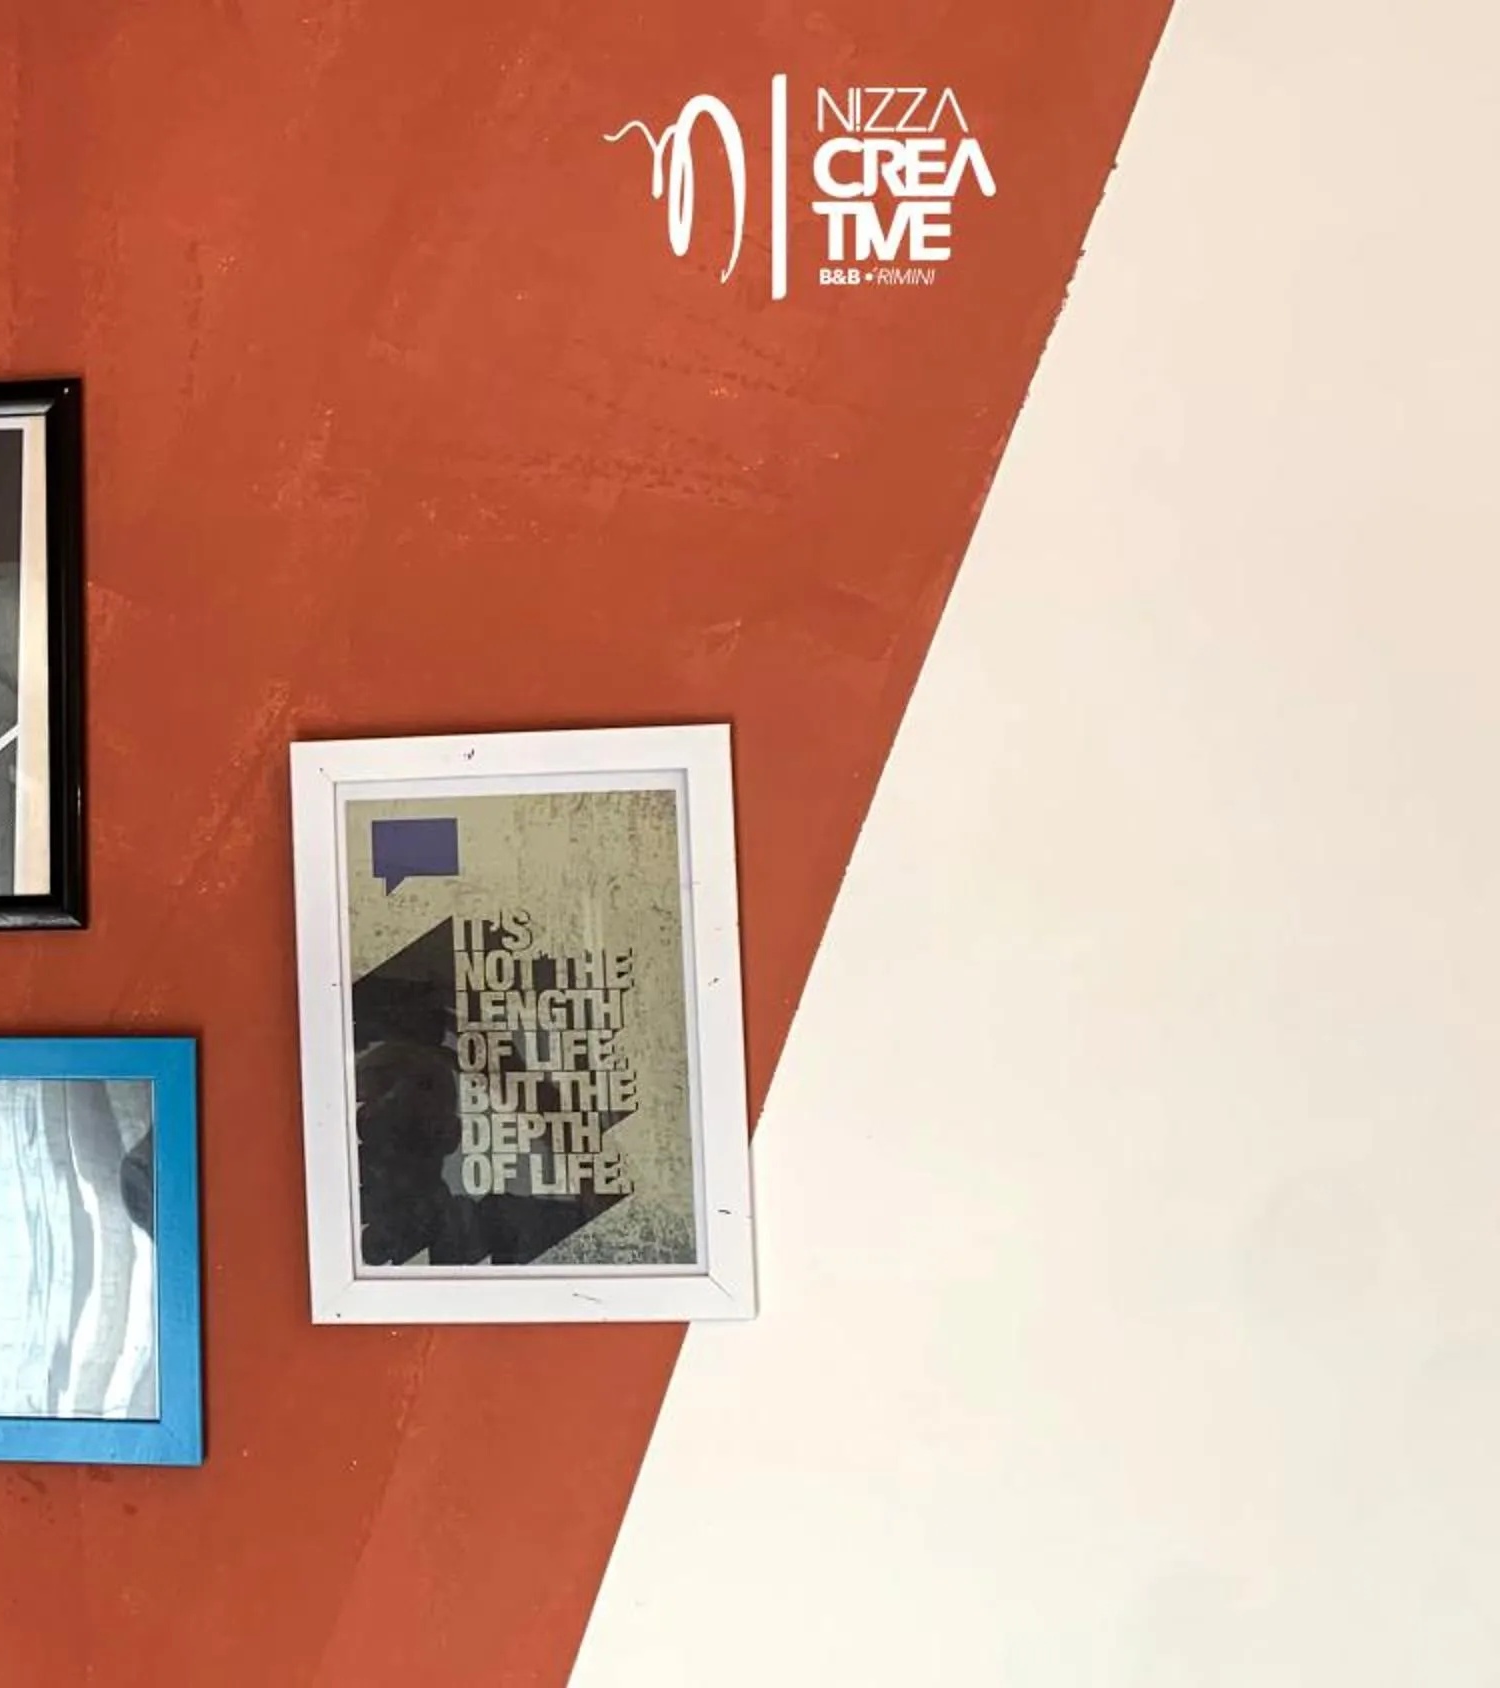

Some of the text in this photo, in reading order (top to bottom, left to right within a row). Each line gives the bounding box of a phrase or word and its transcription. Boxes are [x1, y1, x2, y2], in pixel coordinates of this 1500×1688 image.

[452, 909, 533, 950] IT'S
[454, 949, 635, 991] NOT THE
[456, 989, 625, 1032] LENGTH
[457, 1032, 513, 1072] OF
[459, 1071, 639, 1113] BUT THE
[461, 1112, 602, 1153] DEPTH
[462, 1153, 517, 1194] OF
